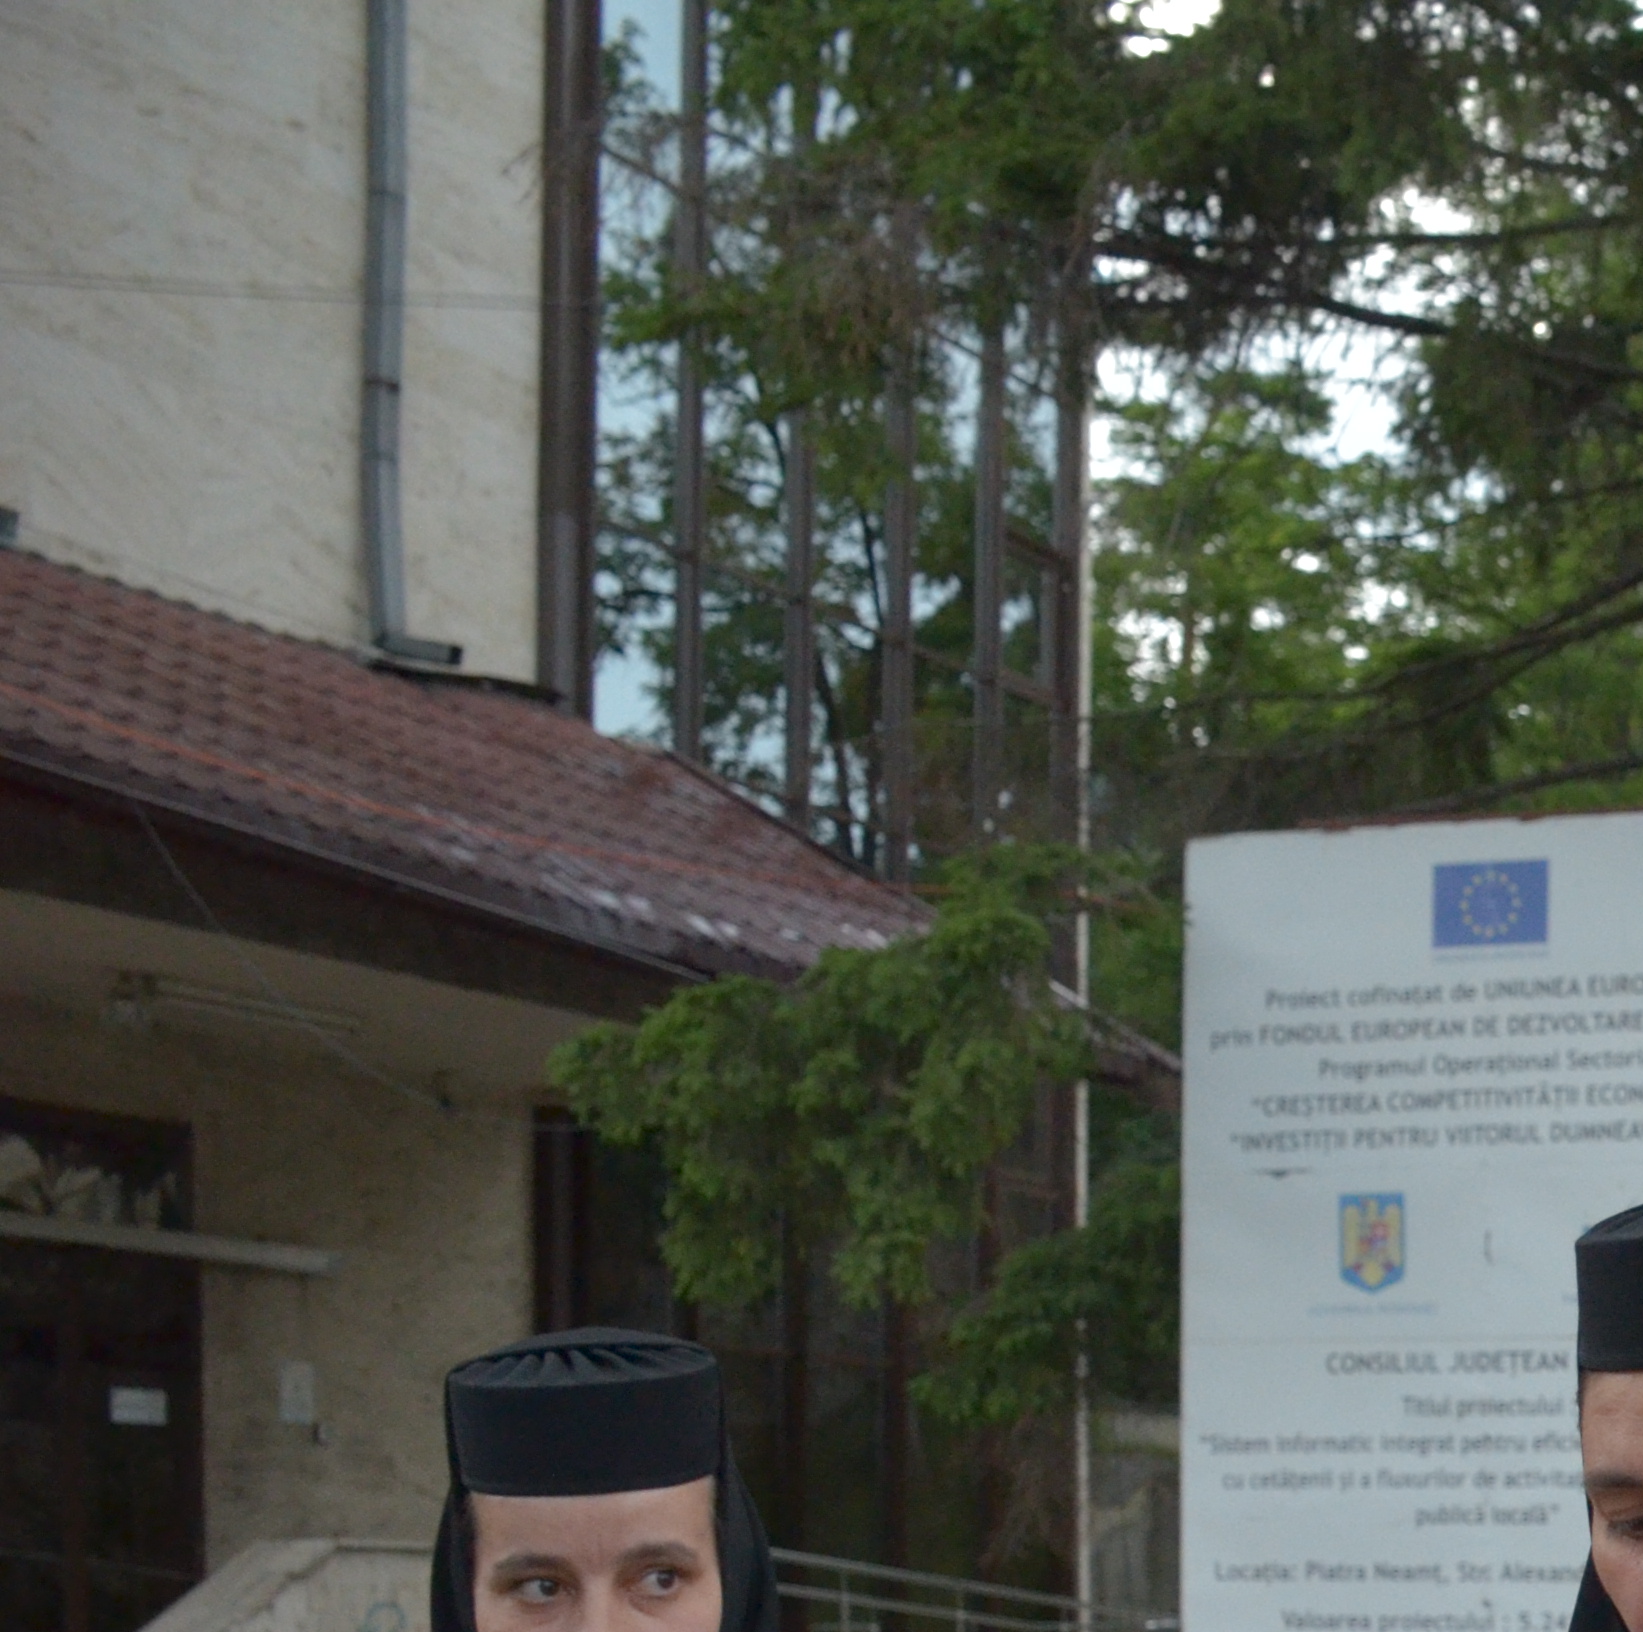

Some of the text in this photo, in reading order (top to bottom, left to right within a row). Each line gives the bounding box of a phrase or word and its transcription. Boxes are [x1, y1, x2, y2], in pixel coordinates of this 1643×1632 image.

[1265, 987, 1340, 1010] Proiect
[1450, 983, 1477, 1003] de
[1484, 976, 1581, 1001] UNIUNEA
[1209, 1028, 1253, 1053] prin
[1258, 1023, 1343, 1046] FONDUL
[1350, 1017, 1467, 1043] EUROPEAN
[1472, 1014, 1500, 1038] DE
[1318, 1055, 1426, 1083] Programul
[1352, 1125, 1440, 1151] PENTRU
[1445, 1122, 1542, 1147] VIITORUL
[1326, 1351, 1440, 1375] CONSILIUL
[1221, 1472, 1246, 1491] cu
[1359, 1471, 1372, 1490] a
[1472, 1467, 1497, 1489] de
[1304, 1560, 1368, 1583] Piatra
[1281, 1609, 1372, 1632] Valoarea
